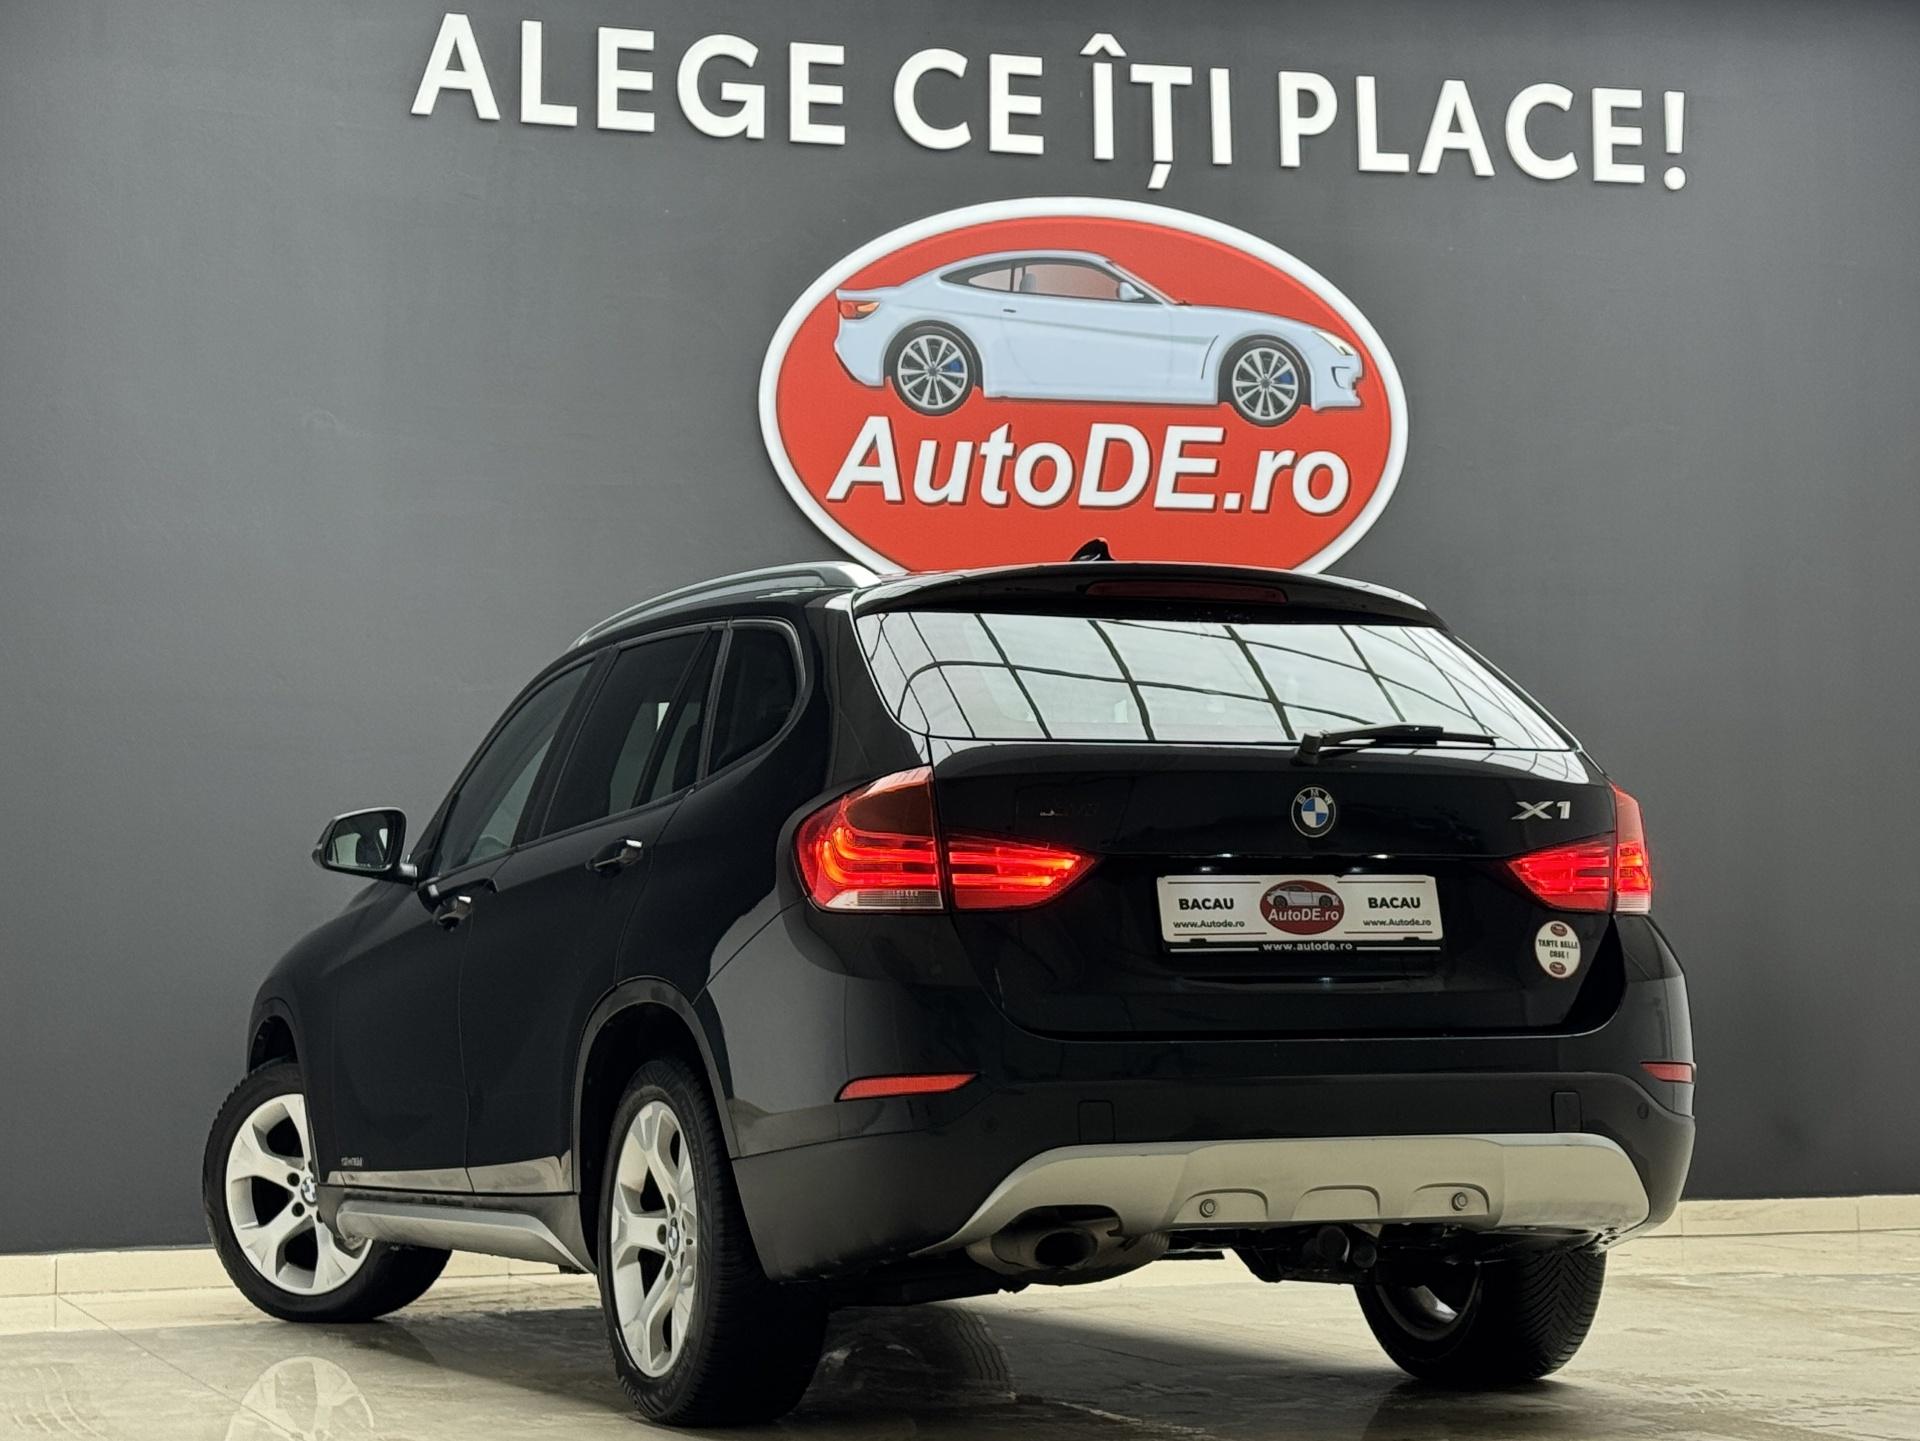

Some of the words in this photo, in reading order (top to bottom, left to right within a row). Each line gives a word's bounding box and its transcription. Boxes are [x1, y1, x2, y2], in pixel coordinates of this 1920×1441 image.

[411, 13, 846, 146] ALEGE
[893, 48, 1044, 155] CE
[1079, 33, 1232, 190] ÎȚI
[1278, 71, 1688, 191] PLACE!
[826, 415, 1350, 515] AutoDE.ro
[1511, 800, 1572, 820] X1
[1178, 898, 1234, 911] BACAU
[1367, 896, 1421, 909] BACAU
[1267, 907, 1340, 922] AutoDE.ro
[1173, 919, 1245, 929] www.Autode.ro
[1362, 918, 1432, 927] www.Autode.ro
[1262, 941, 1353, 951] www.autode.ro
